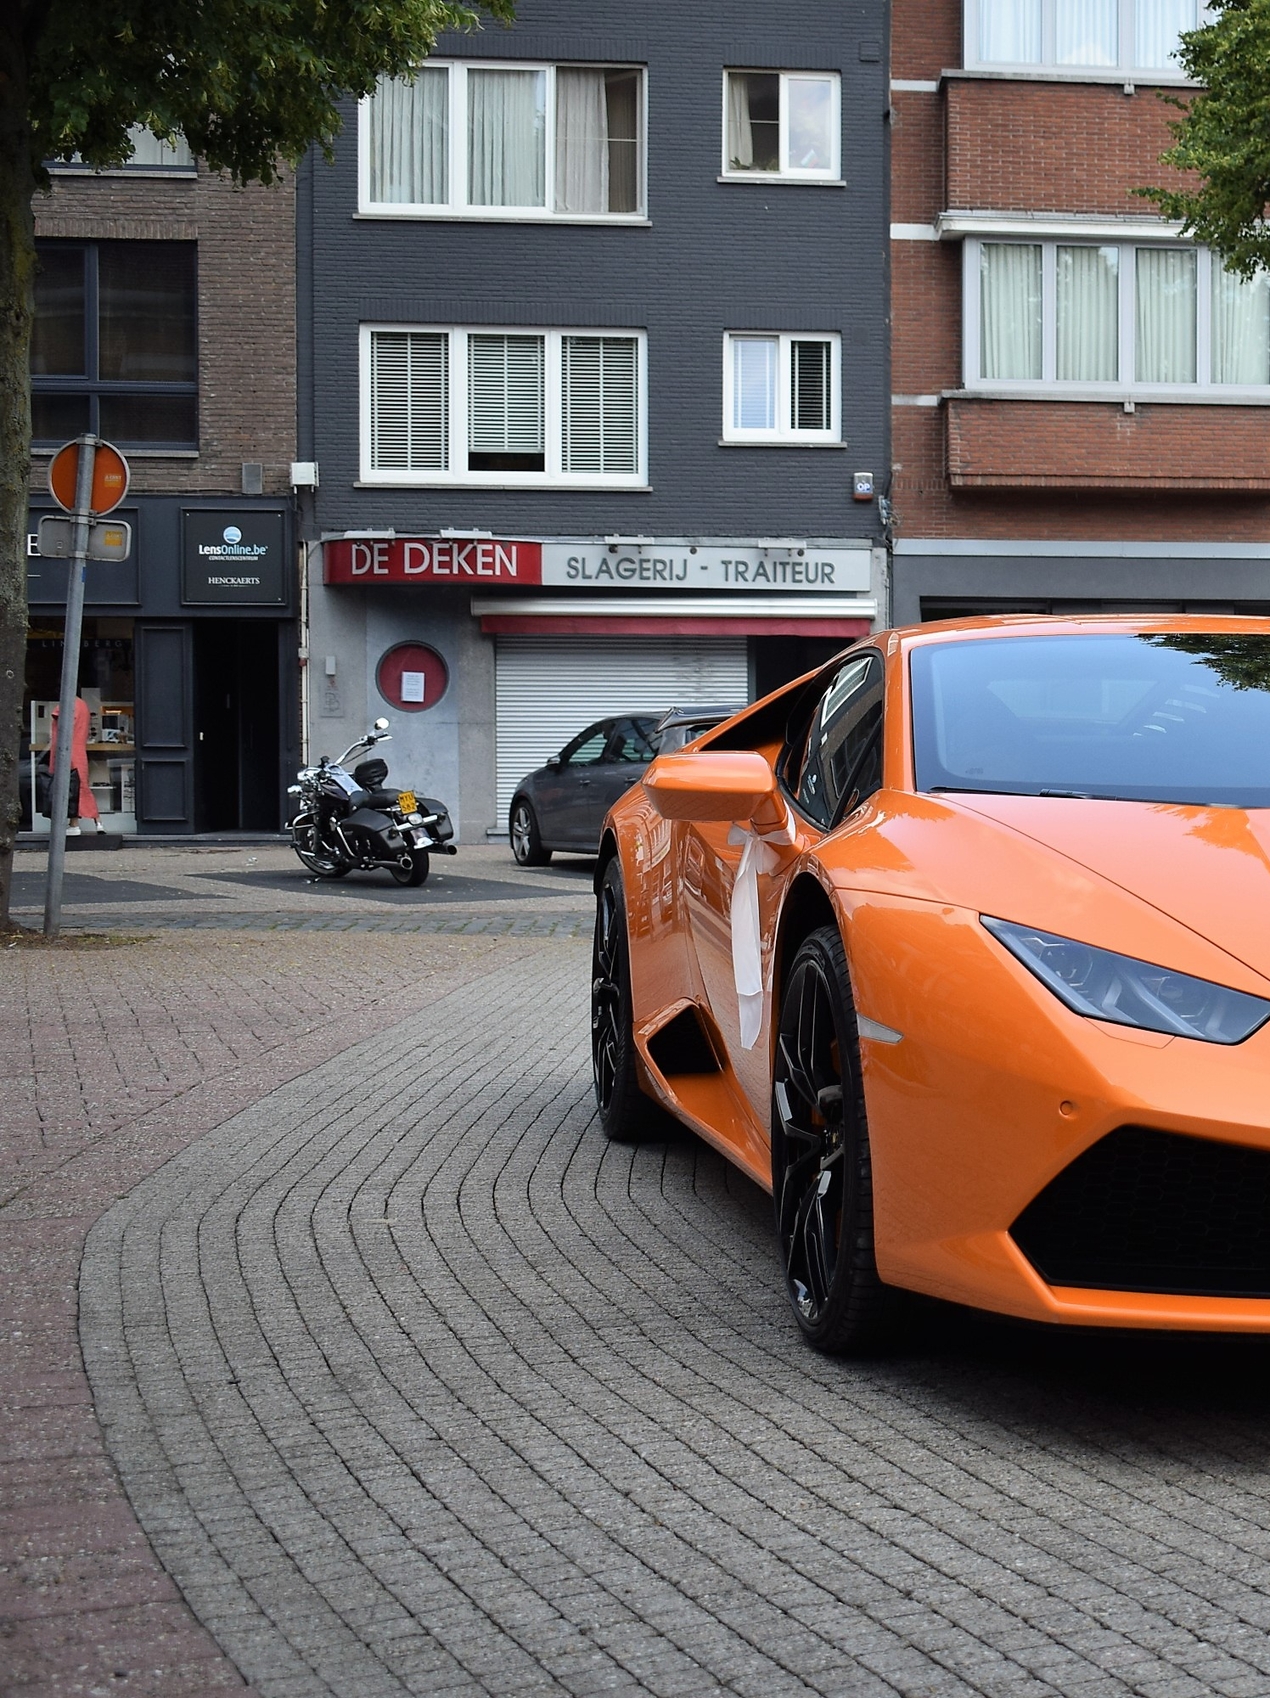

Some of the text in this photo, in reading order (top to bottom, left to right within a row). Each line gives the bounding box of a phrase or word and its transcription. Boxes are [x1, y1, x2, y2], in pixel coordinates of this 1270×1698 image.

[199, 544, 266, 555] LensOnline.be
[352, 542, 517, 577] DE DEKEN
[566, 557, 688, 581] SLAGERIJ
[721, 560, 836, 584] TRAITEUR
[208, 577, 260, 585] HENCKAERTS
[42, 640, 122, 648] LINBERG
